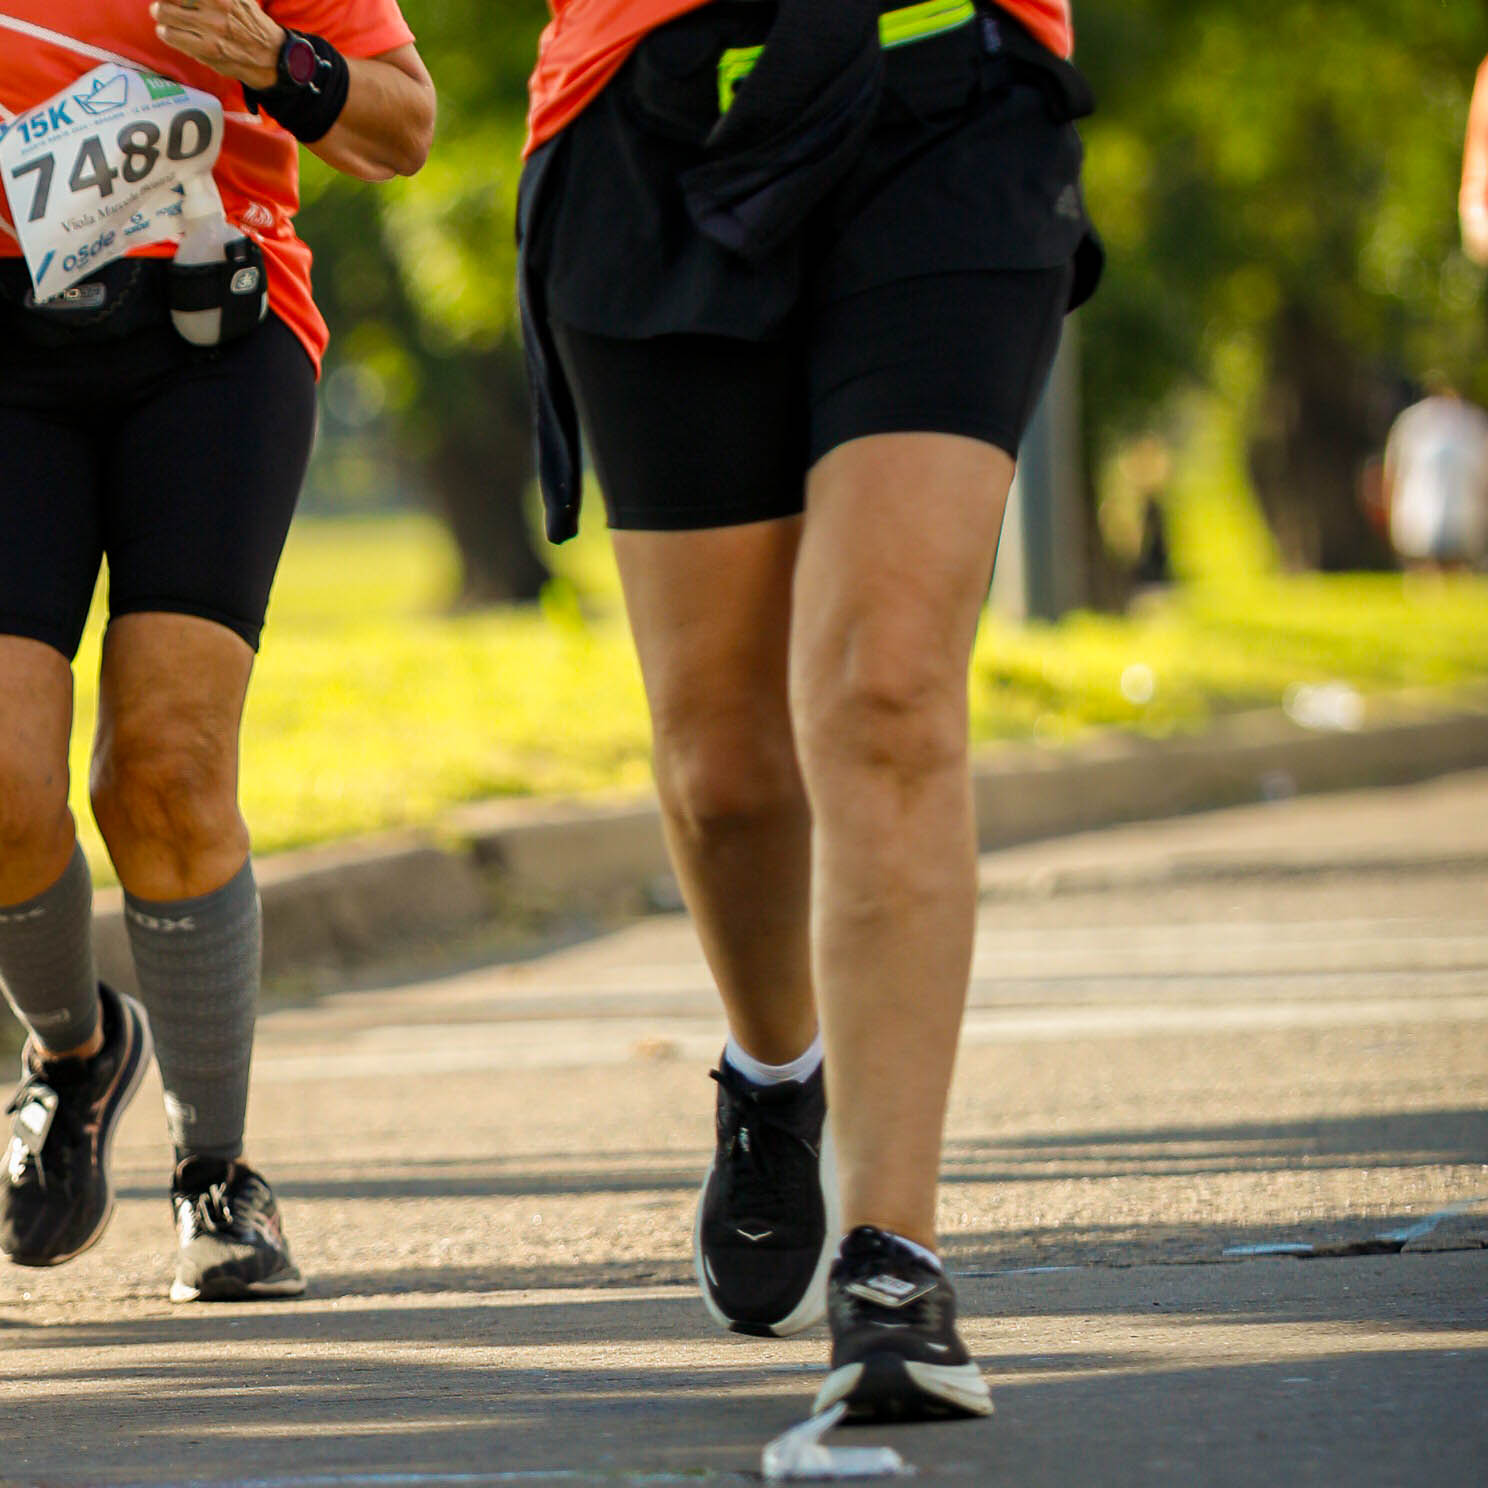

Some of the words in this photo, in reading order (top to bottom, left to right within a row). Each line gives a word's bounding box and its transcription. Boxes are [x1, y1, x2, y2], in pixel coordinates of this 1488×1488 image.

[17, 99, 74, 144] 15K
[11, 108, 212, 223] 7480
[63, 230, 116, 272] osde
